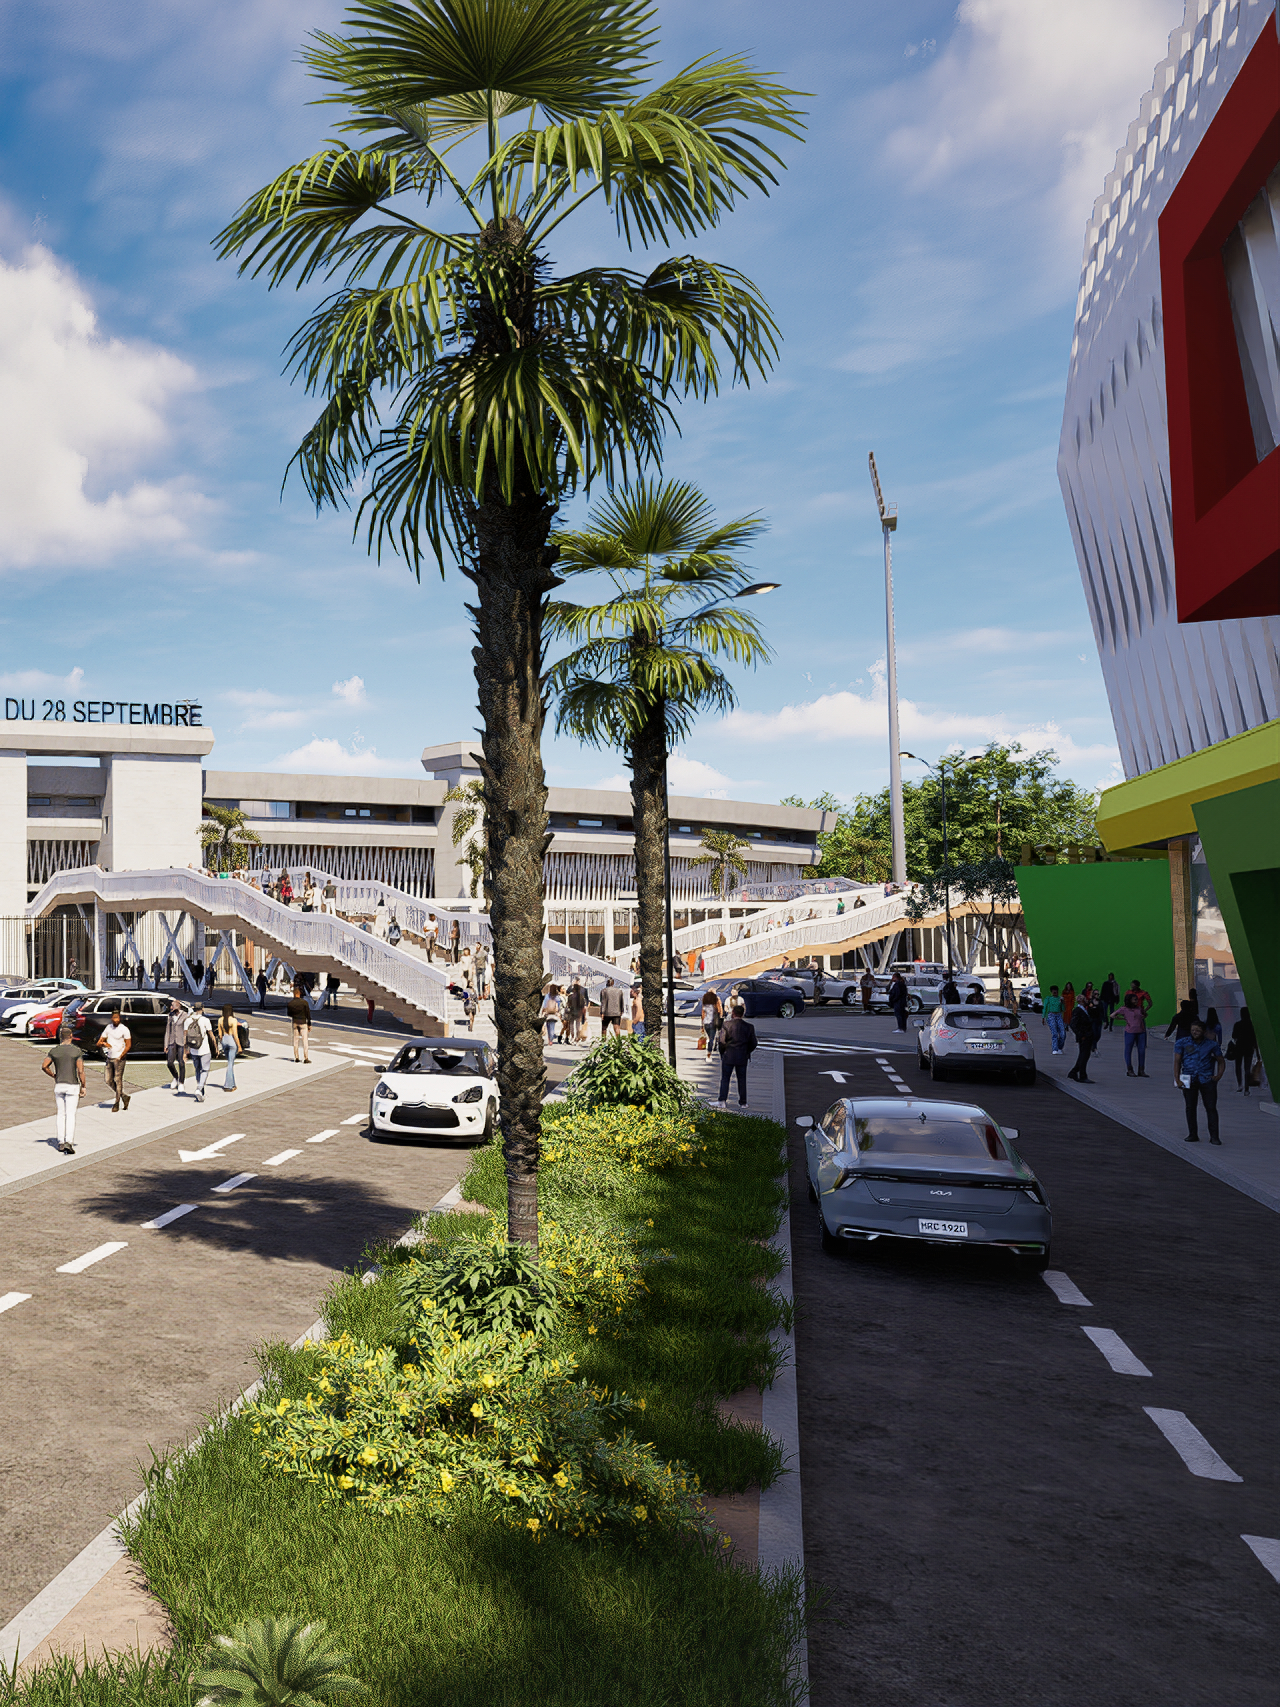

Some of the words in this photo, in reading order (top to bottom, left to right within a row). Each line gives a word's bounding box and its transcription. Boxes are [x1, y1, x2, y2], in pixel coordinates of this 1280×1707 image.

[5, 698, 35, 721] DU
[42, 700, 66, 722] 28
[73, 701, 203, 727] SEPTEMBRE
[942, 1223, 965, 1233] 1920
